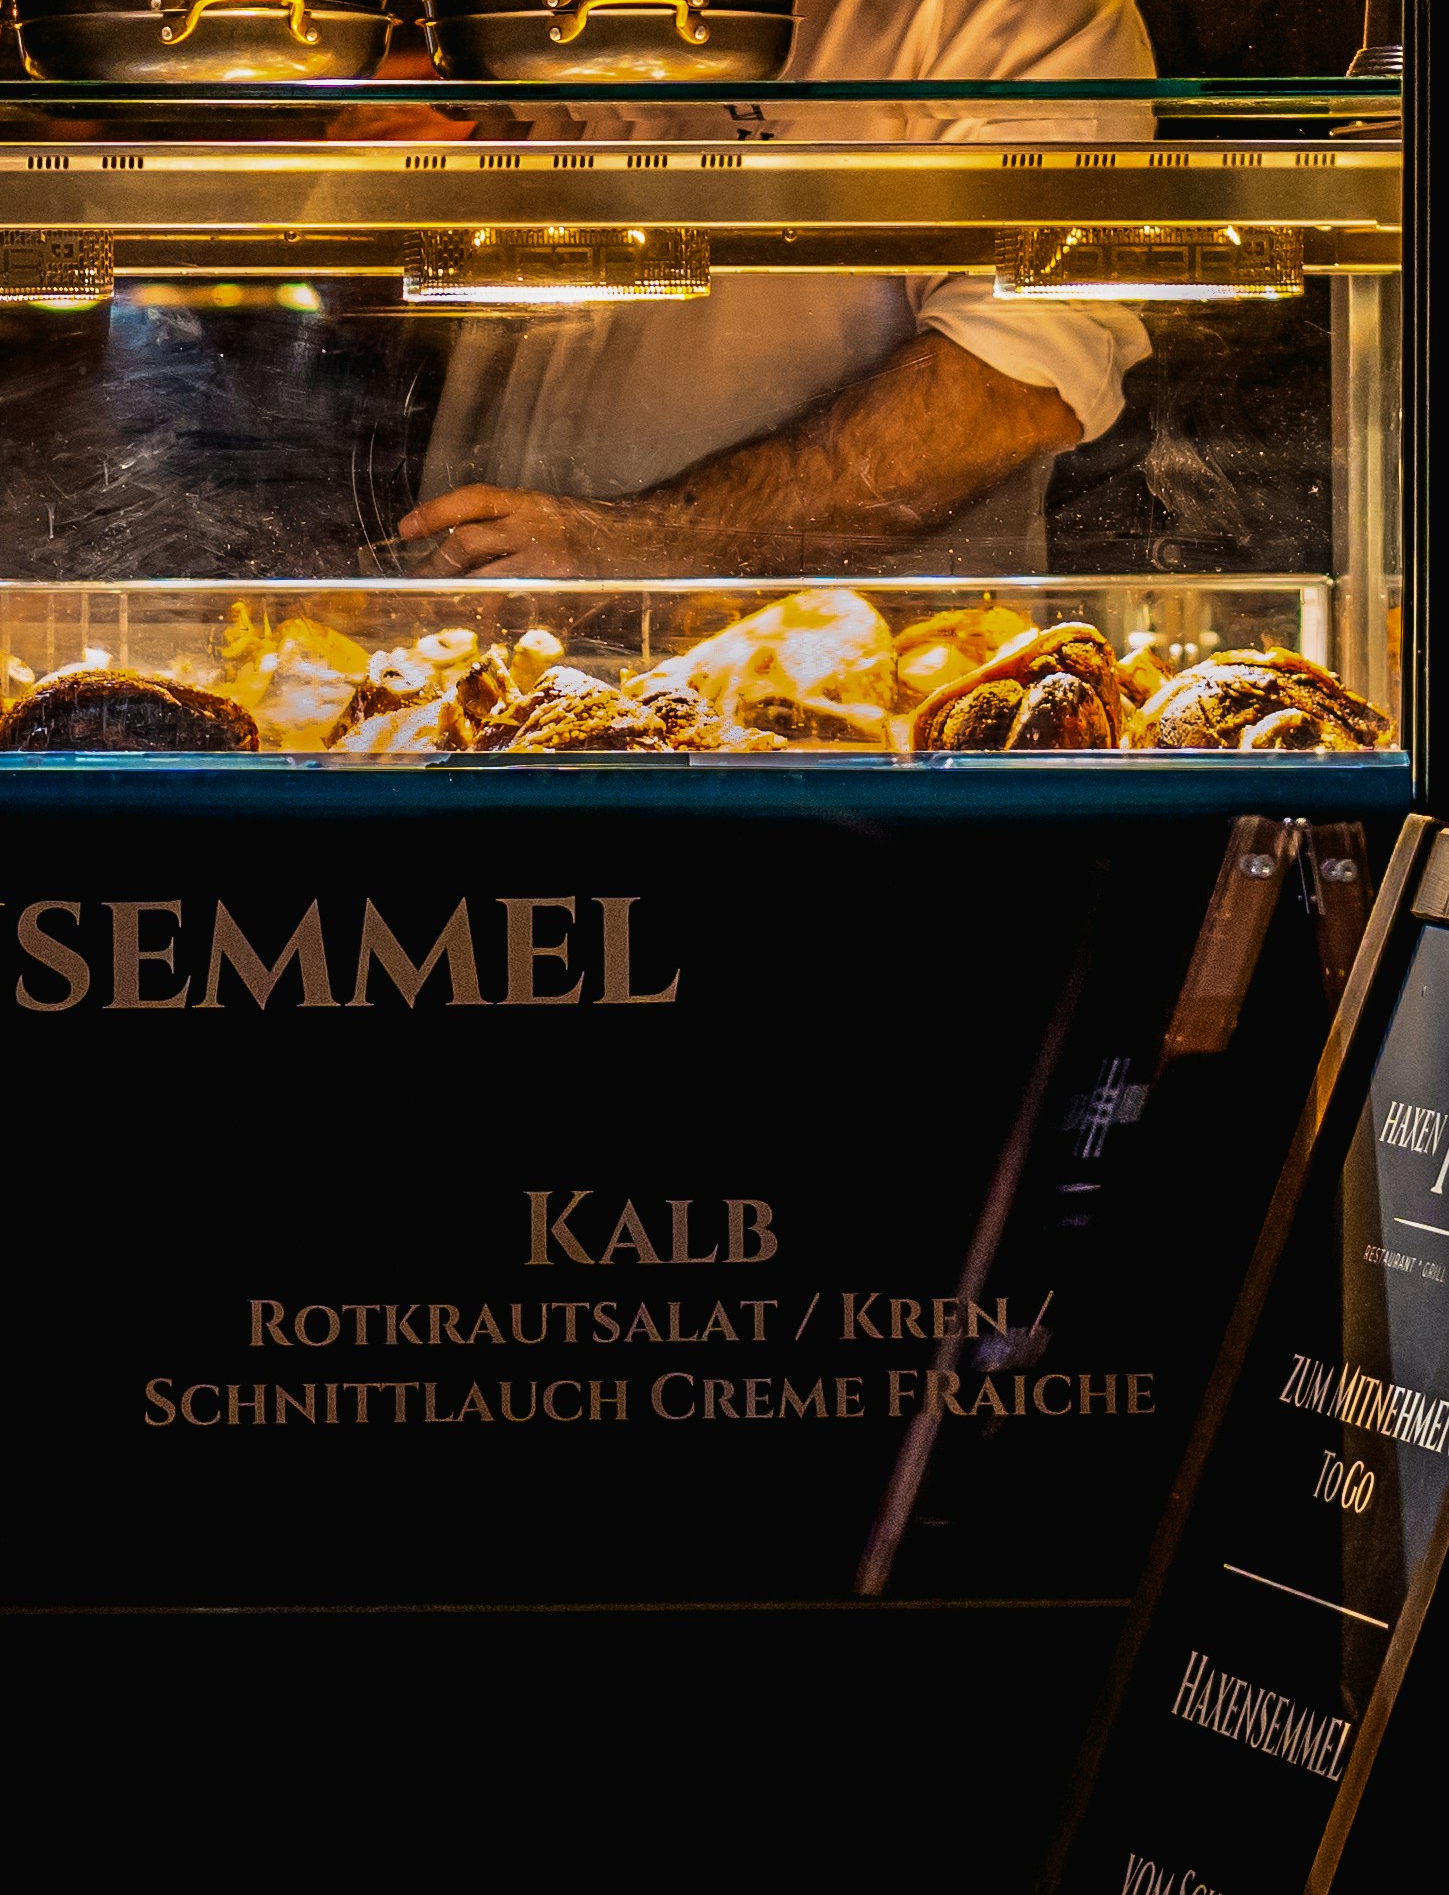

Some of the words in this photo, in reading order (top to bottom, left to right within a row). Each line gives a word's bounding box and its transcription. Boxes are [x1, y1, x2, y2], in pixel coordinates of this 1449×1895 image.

[1379, 1100, 1449, 1158] HAXEN
[523, 1188, 780, 1267] KALB
[1364, 1244, 1417, 1273] RESTAURANT
[1422, 1262, 1447, 1283] GRILL
[248, 1298, 780, 1349] ROTKRAUTSALAT
[840, 1291, 1010, 1340] KREN
[142, 1376, 629, 1428] SCHNITTLAUCH
[649, 1370, 866, 1422] CREME
[887, 1367, 1157, 1417] FRAICHE
[1278, 1353, 1336, 1415] ZUM
[1312, 1449, 1345, 1503] TO
[1340, 1460, 1375, 1513] GO
[1170, 1649, 1352, 1782] HAXENSEMMEL
